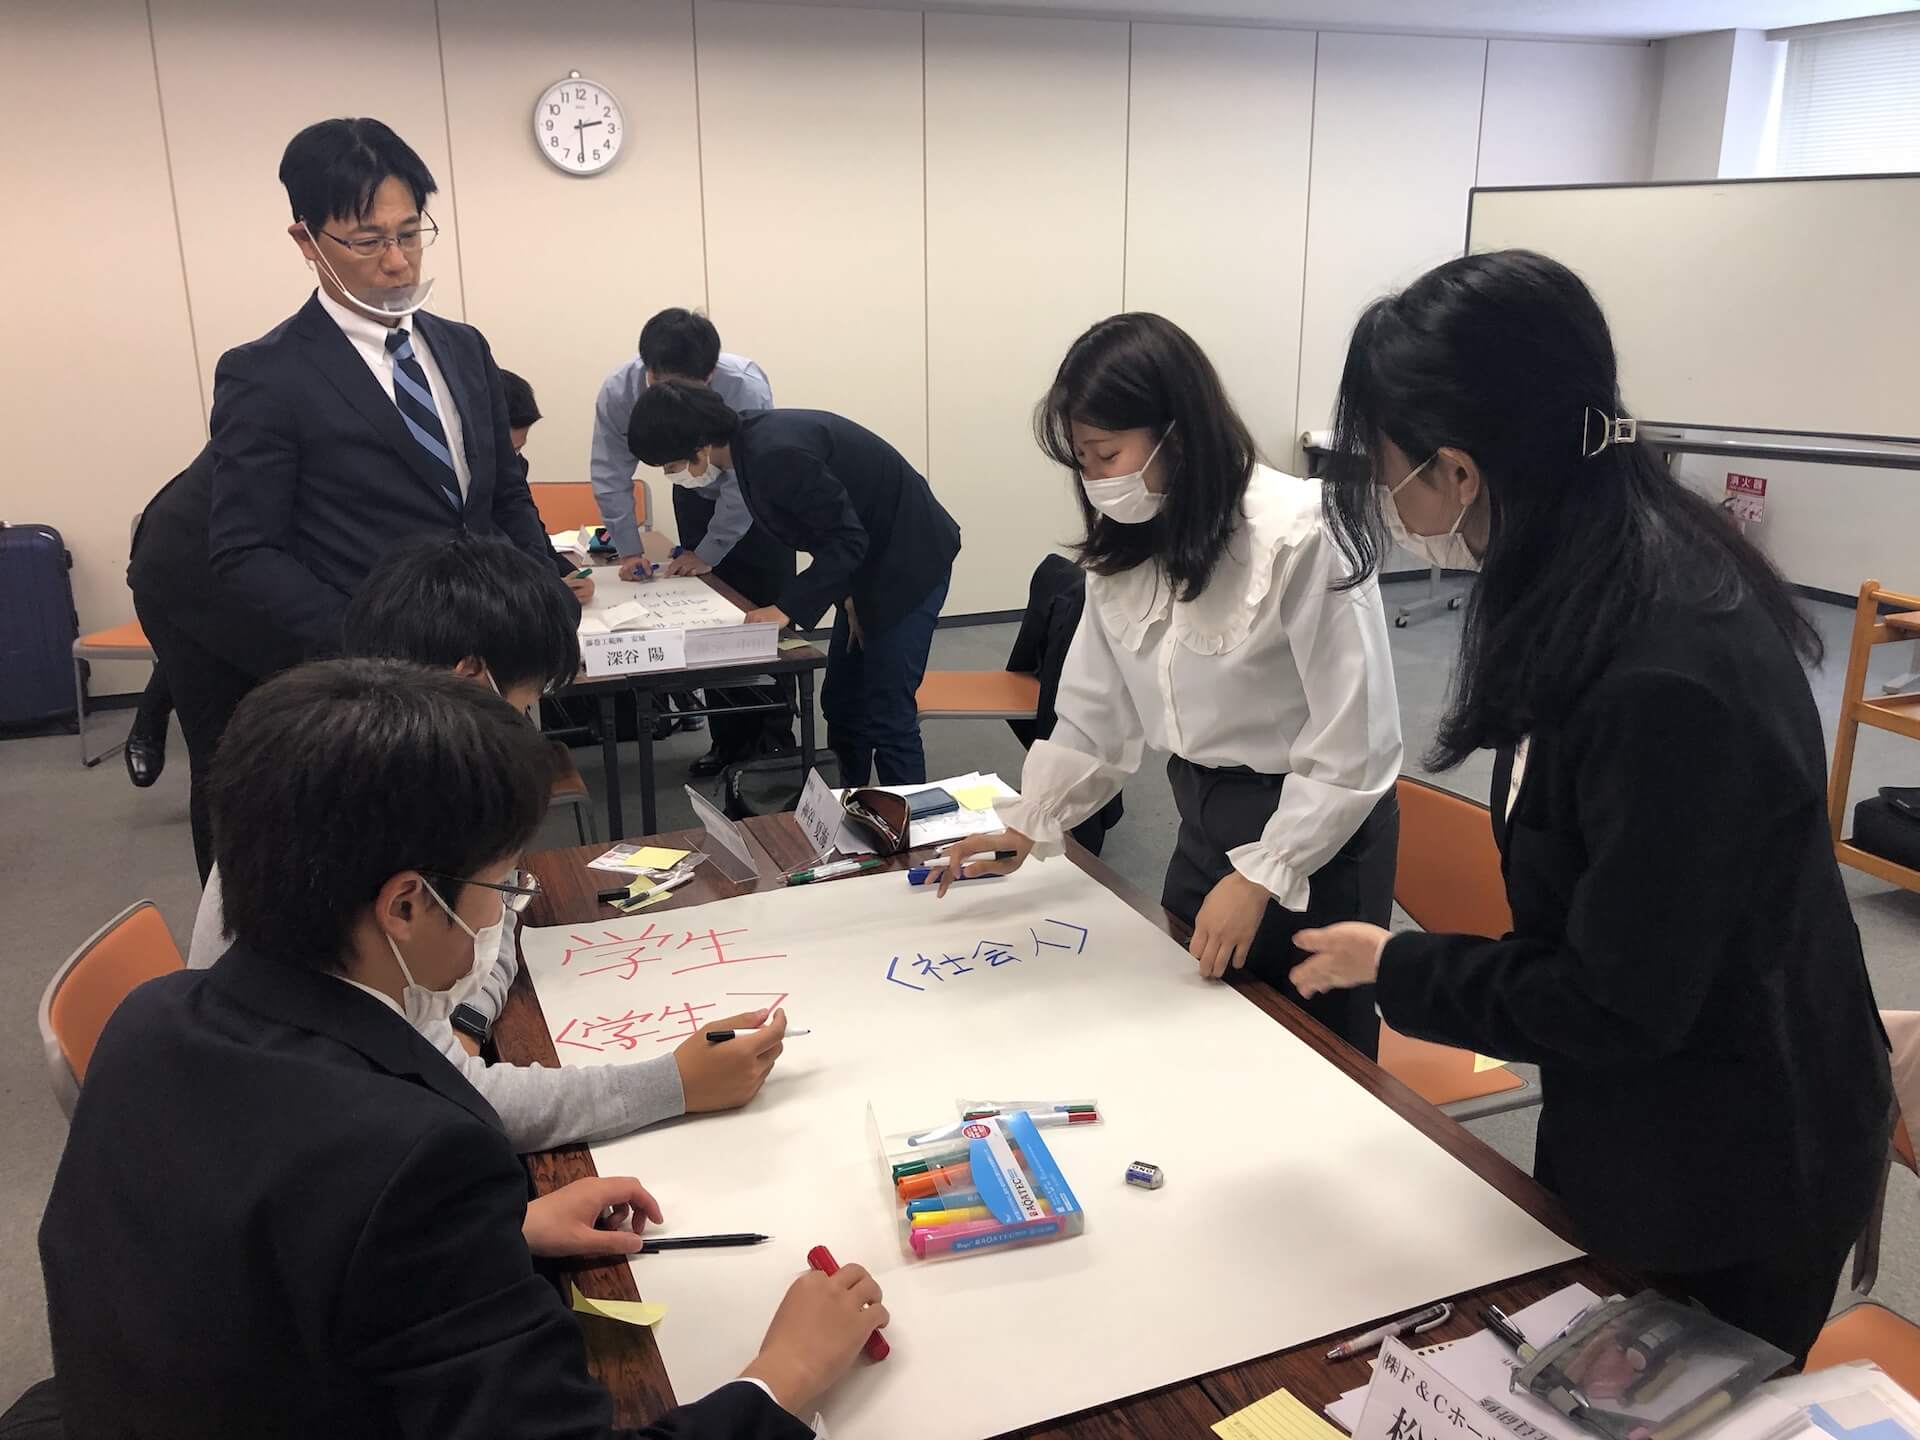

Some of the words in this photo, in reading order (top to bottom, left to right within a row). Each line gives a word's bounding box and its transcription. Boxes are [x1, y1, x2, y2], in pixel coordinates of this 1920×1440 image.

[560, 92, 570, 104] 11
[575, 88, 587, 101] 12
[594, 94, 599, 106] 1
[549, 104, 561, 116] 10
[603, 106, 611, 118] 2
[545, 120, 554, 131] 9
[607, 123, 616, 134] 3
[551, 136, 559, 147] 8
[603, 139, 611, 150] 4
[563, 148, 570, 159] 7
[577, 152, 585, 164] 6
[593, 149, 601, 161] 5
[607, 648, 639, 666] 深谷
[648, 646, 664, 663] 陽
[561, 923, 787, 980] 学生
[1383, 1351, 1495, 1440] (株)F&Cホー
[1386, 1406, 1437, 1440] 松
